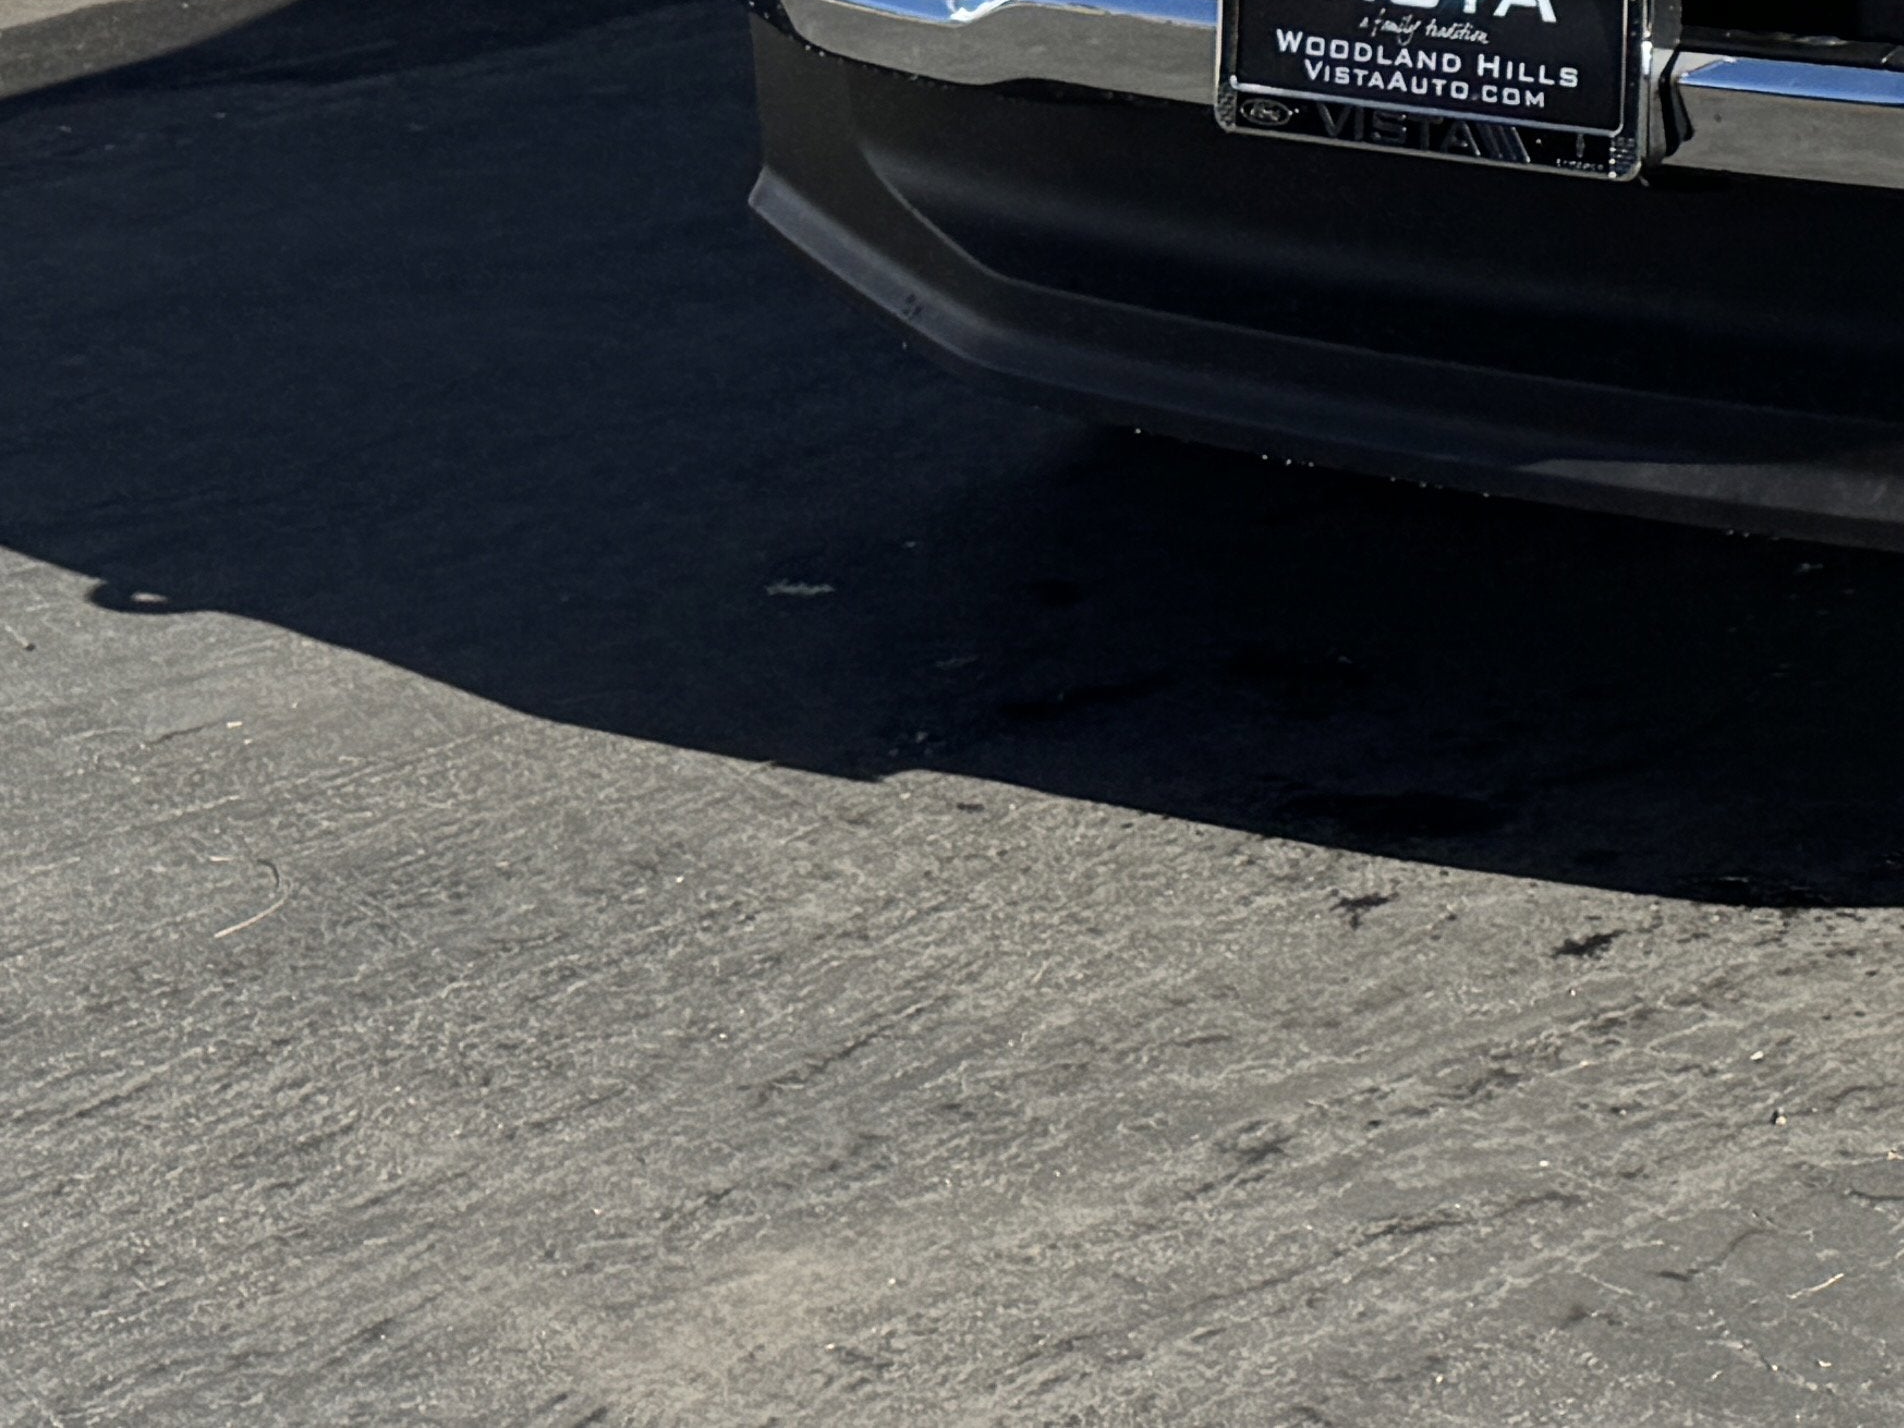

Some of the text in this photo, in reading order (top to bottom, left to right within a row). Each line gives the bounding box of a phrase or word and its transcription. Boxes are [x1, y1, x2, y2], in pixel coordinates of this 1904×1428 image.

[1371, 7, 1422, 46] family
[1424, 17, 1491, 45] tradition
[1276, 28, 1580, 89] WOODLAND HILLS
[1303, 58, 1546, 108] VISTAAUTO.COM
[1316, 101, 1481, 156] VISTA
